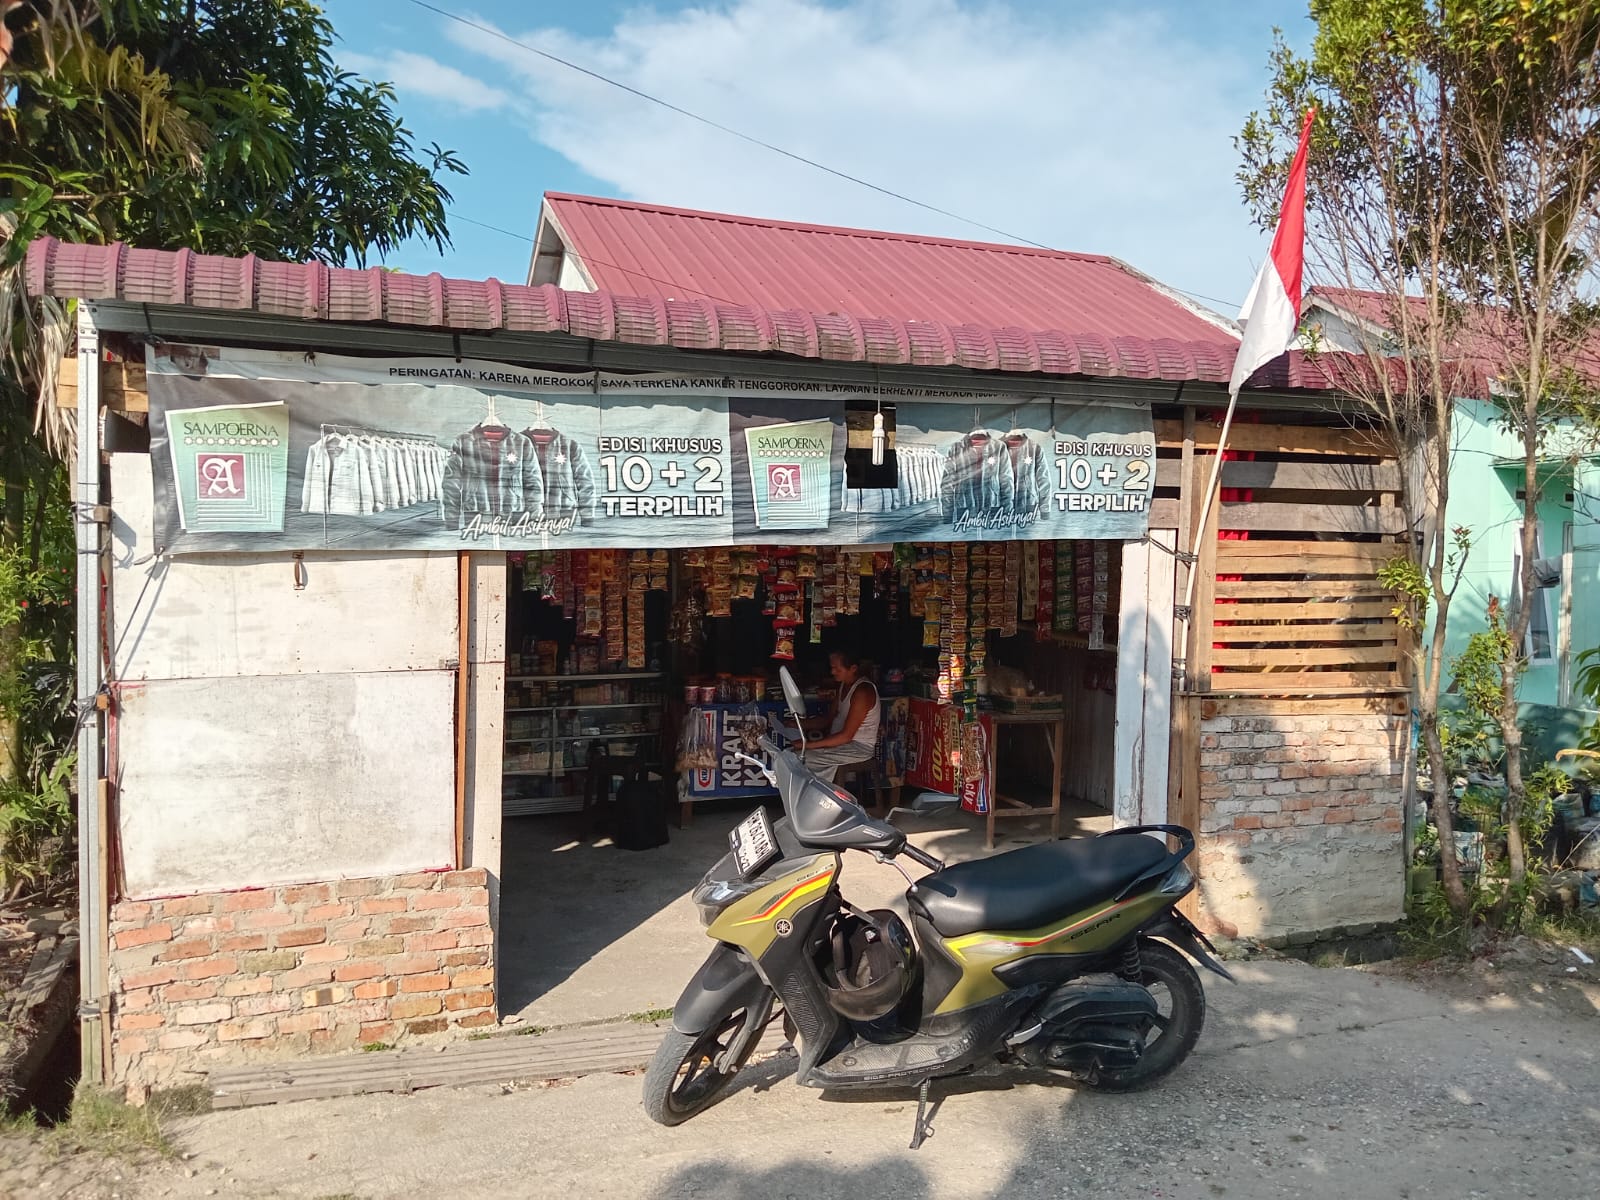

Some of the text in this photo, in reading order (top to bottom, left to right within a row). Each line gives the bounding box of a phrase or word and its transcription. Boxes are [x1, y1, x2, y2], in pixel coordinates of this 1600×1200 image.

[389, 367, 476, 379] PERINGATAN:
[479, 371, 530, 385] KARENA
[533, 375, 595, 388] MEROKOK
[601, 379, 632, 388] SAYA
[633, 379, 688, 389] TERKENA
[690, 378, 736, 389] KANKER
[738, 380, 823, 392] TENGGOROKAN.
[825, 383, 871, 393] LAYANAN
[873, 385, 922, 396] BERHENTI
[183, 421, 279, 437] SAMPOERNA
[599, 436, 722, 454] EDISI KHUSUS
[757, 436, 825, 450] SAMPOERNA
[1054, 441, 1153, 457] EDISI KHUSUS
[600, 455, 652, 493] 10
[694, 455, 724, 493] 2
[1054, 458, 1092, 490] 10
[1122, 459, 1151, 491] 2
[601, 495, 724, 516] TERPILIH
[1054, 493, 1145, 512] TERPILIH
[460, 507, 579, 541] Ambil Asiknya!
[954, 504, 1039, 533] Ambil Asiknya!
[721, 710, 743, 787] KRAFT
[863, 1063, 945, 1081] SIDE PROTECTION
